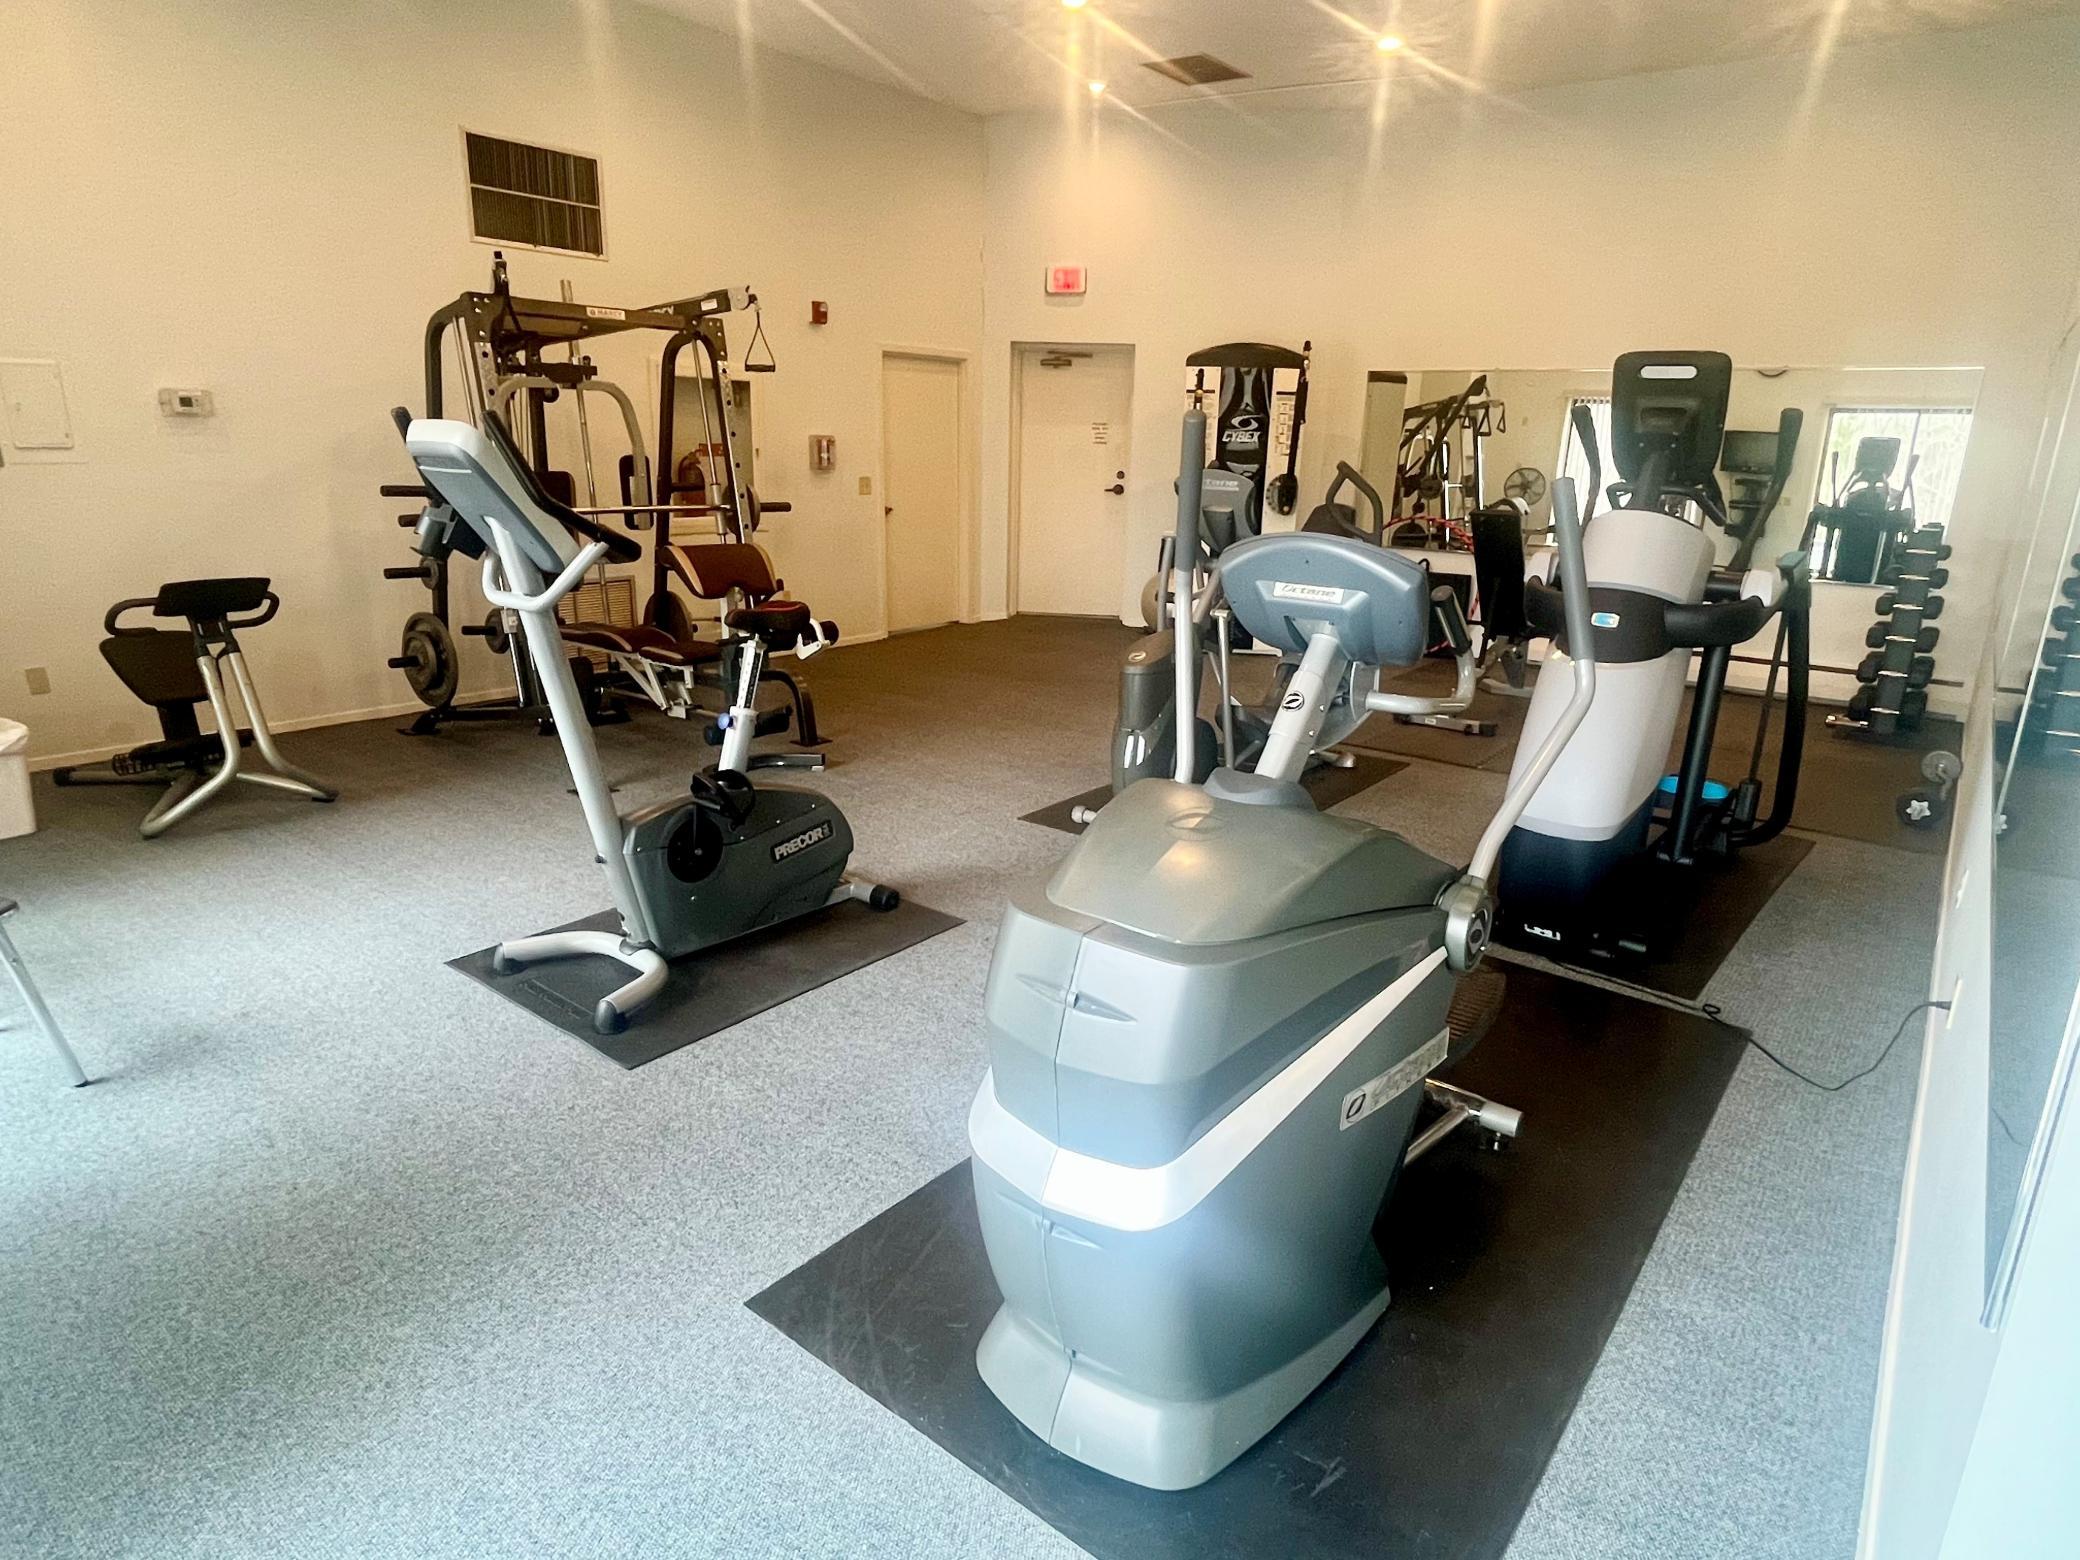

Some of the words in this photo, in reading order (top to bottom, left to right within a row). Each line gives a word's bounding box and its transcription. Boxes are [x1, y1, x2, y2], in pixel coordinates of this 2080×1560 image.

[1221, 431, 1261, 442] CYBEX
[1281, 584, 1336, 597] Octane
[774, 827, 824, 860] PRECOR
